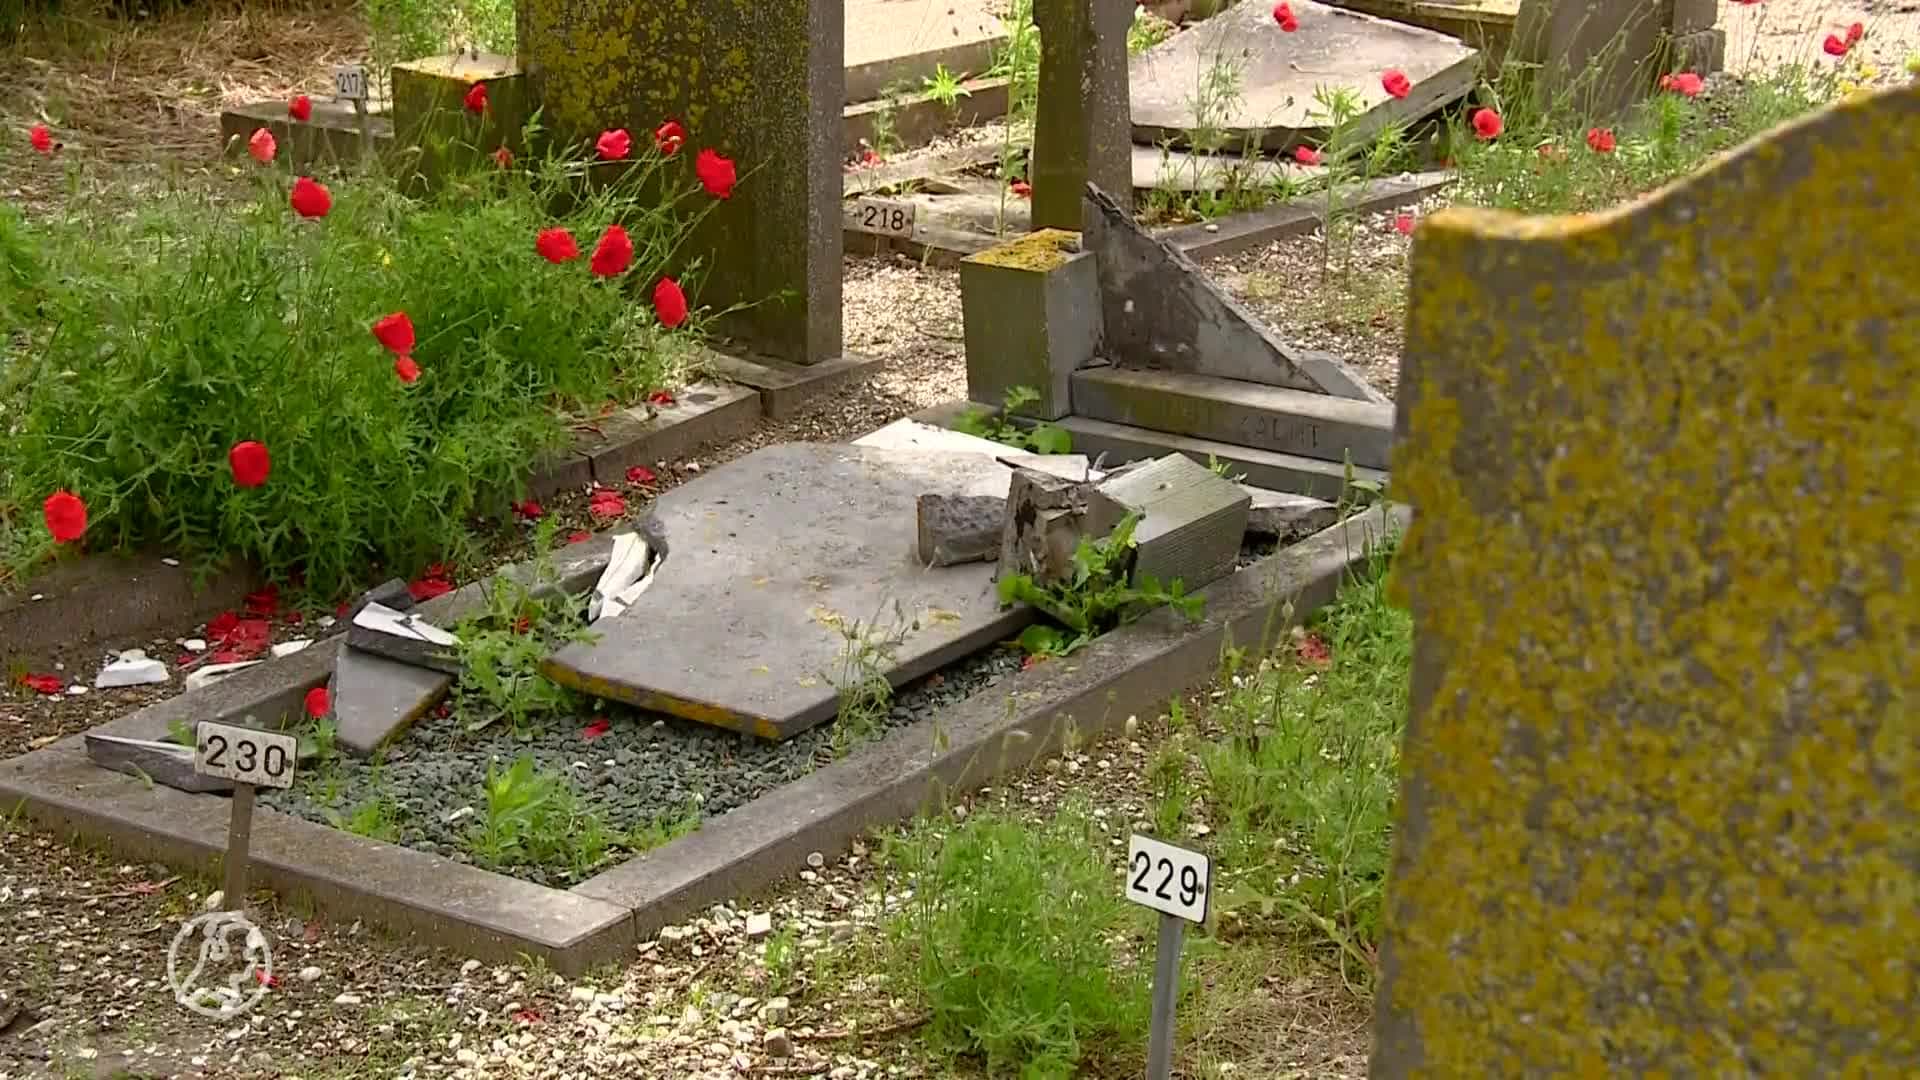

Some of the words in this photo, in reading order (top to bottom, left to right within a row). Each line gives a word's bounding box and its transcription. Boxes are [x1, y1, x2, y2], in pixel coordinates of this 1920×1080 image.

[338, 72, 359, 94] 217
[863, 206, 904, 230] 218
[206, 735, 286, 777] 230
[1132, 850, 1198, 907] 229
